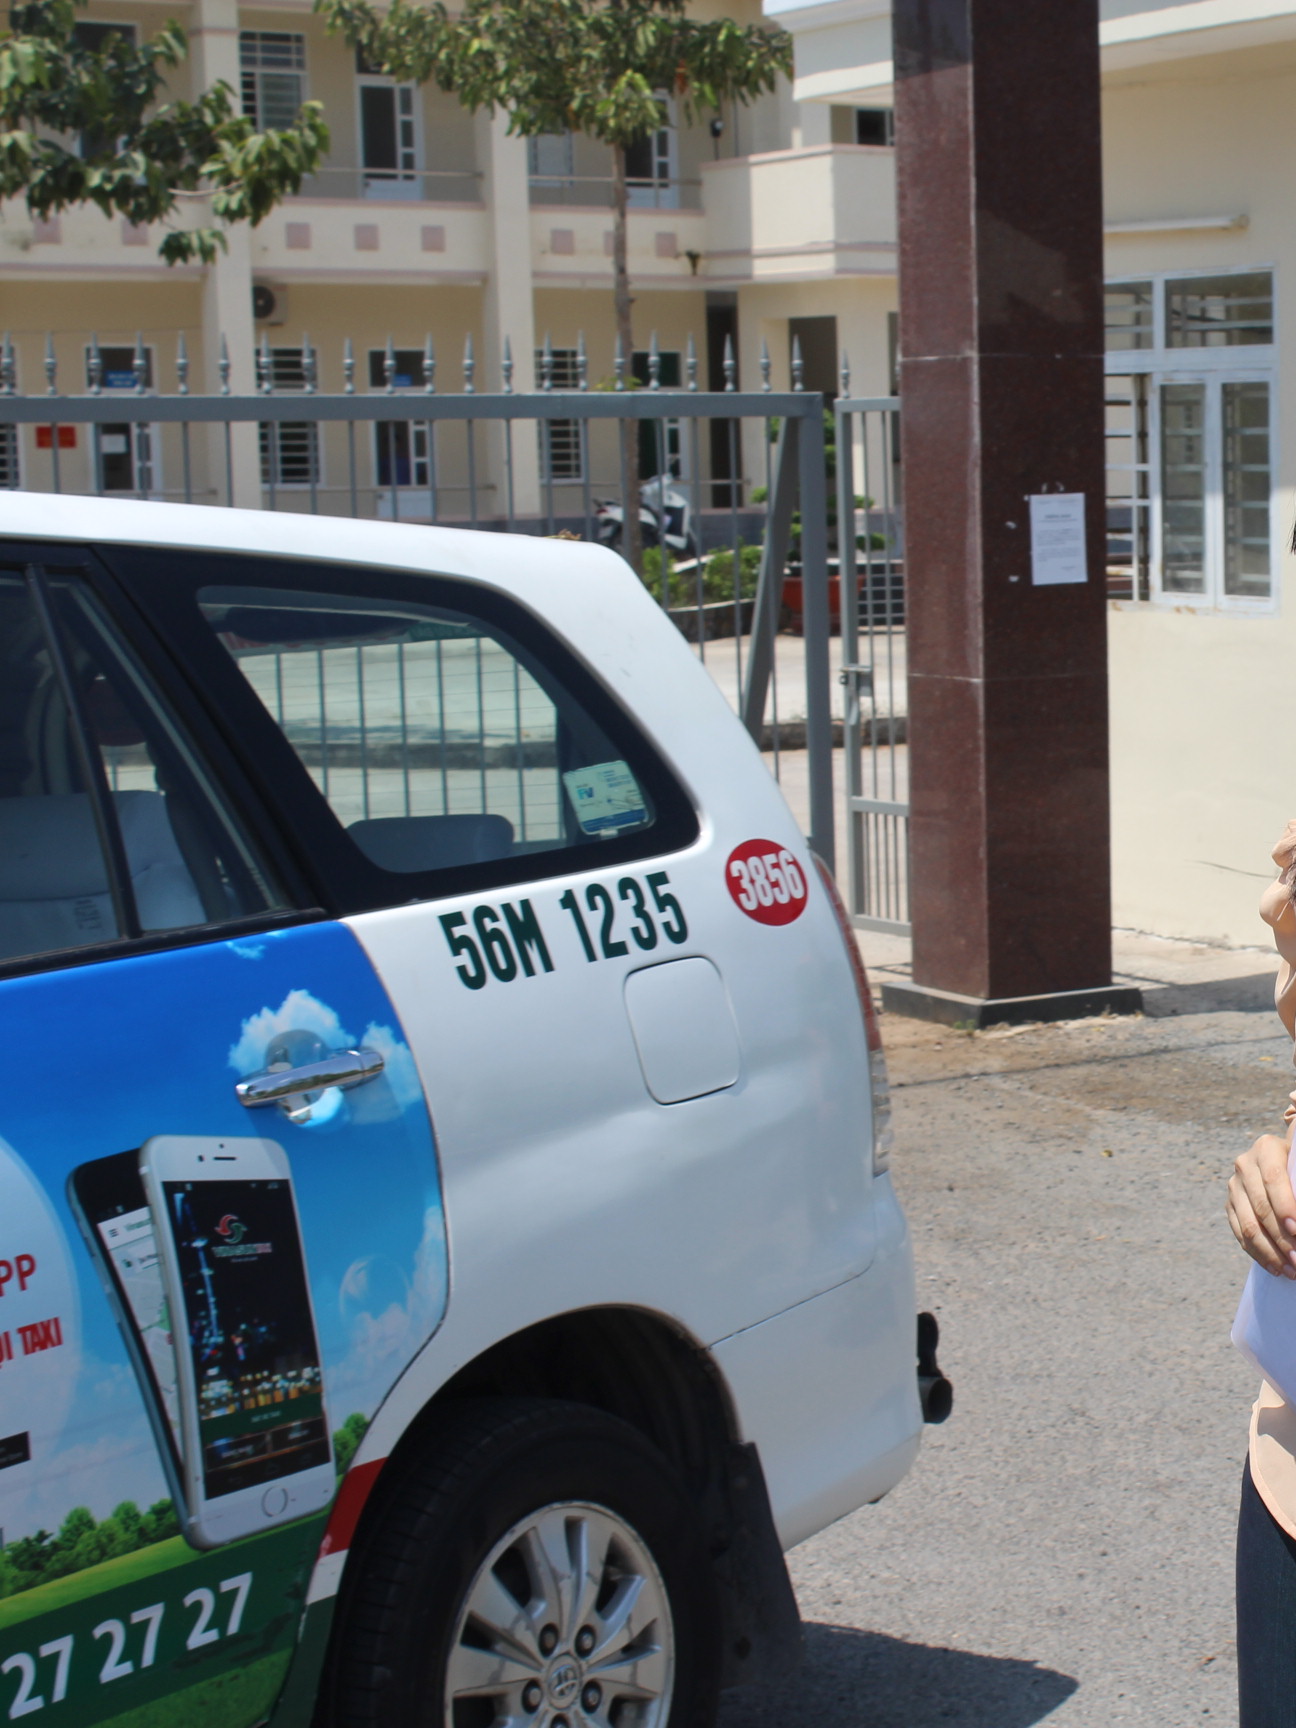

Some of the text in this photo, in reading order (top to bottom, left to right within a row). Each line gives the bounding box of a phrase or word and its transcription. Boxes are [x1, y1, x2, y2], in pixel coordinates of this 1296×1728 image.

[730, 848, 805, 912] 3856
[438, 870, 689, 990] 56M 1235
[16, 1316, 64, 1356] TAXI
[0, 1571, 253, 1720] 27 27 27
